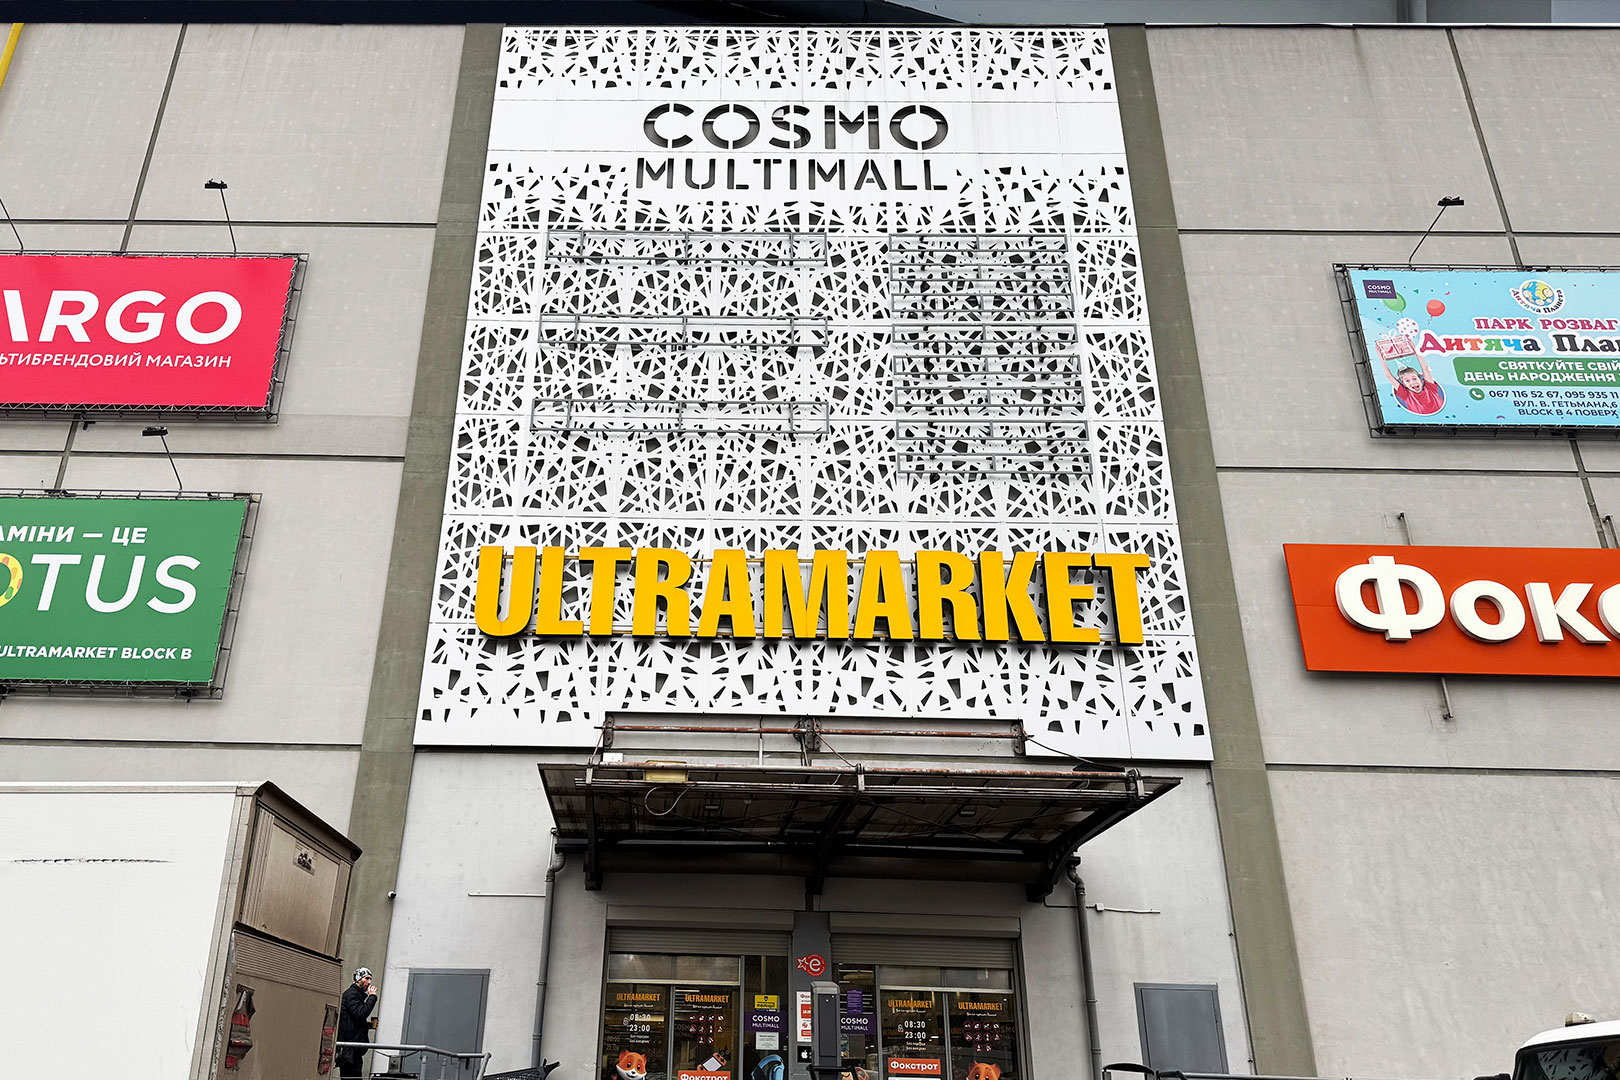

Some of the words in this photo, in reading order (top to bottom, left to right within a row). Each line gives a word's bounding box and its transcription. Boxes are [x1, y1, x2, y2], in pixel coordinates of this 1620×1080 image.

[643, 102, 948, 151] COSMO
[635, 157, 949, 192] MULTIMALL
[1474, 318, 1534, 330] ПАРК
[1540, 319, 1618, 331] РОЗВАГ
[1420, 332, 1541, 353] Дитяча
[145, 354, 231, 368] МАГАЗИН
[1498, 360, 1585, 371] СВЯТКУЙТЕ
[1464, 371, 1504, 382] ДЕНЬ
[1507, 372, 1617, 383] НАРОДЖЕННЯ
[1489, 390, 1509, 398] 067
[1512, 390, 1529, 398] 116
[1530, 390, 1544, 398] 52
[1546, 390, 1563, 400] 67,
[1564, 391, 1586, 399] 095
[1587, 391, 1608, 399] 935
[1610, 391, 1619, 399] 11
[1540, 400, 1550, 408] В.
[1518, 408, 1554, 416] BLOCK
[111, 527, 148, 546] ЦЕ
[474, 546, 1150, 646] ULTRAMARKET
[0, 645, 120, 659] ULTRAMARKET
[121, 647, 177, 660] BLOCK
[180, 648, 193, 660] B
[616, 993, 660, 1001] ULTRAMARKET
[685, 994, 729, 1003] ULTRAMARKET
[888, 1000, 933, 1008] ULTRAMARKET
[958, 1002, 1003, 1011] ULTRAMARKET
[752, 1014, 780, 1022] COSMO
[629, 1024, 651, 1032] 23:00
[904, 1020, 926, 1028] 08:30
[904, 1031, 927, 1039] 23:00
[890, 1061, 938, 1071] Фокстрот
